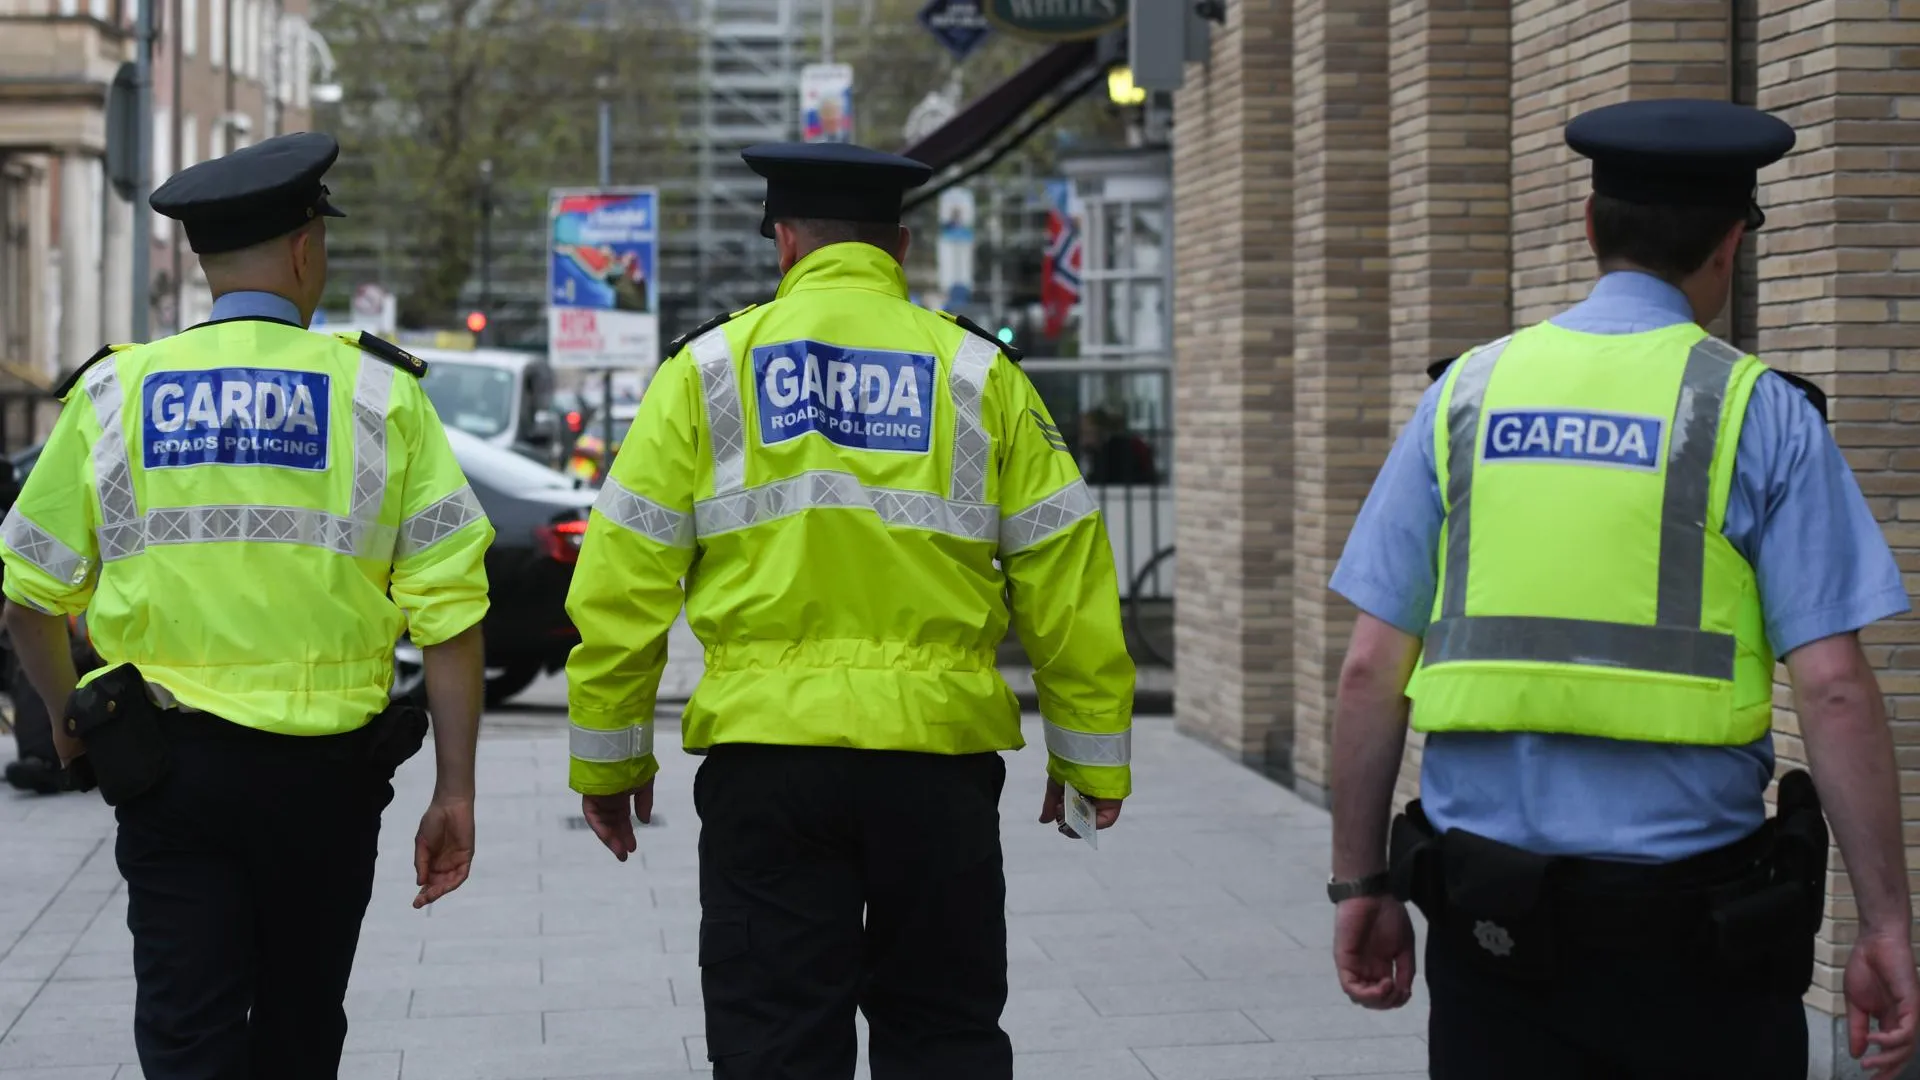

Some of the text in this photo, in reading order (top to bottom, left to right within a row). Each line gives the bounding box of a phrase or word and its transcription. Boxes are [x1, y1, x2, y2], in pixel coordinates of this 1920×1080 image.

[765, 353, 923, 418] GARDA
[152, 380, 319, 435] GARDA
[771, 405, 922, 439] ROADS POLICING
[153, 436, 319, 456] ROADS POLICING
[1492, 416, 1649, 459] GARDA
